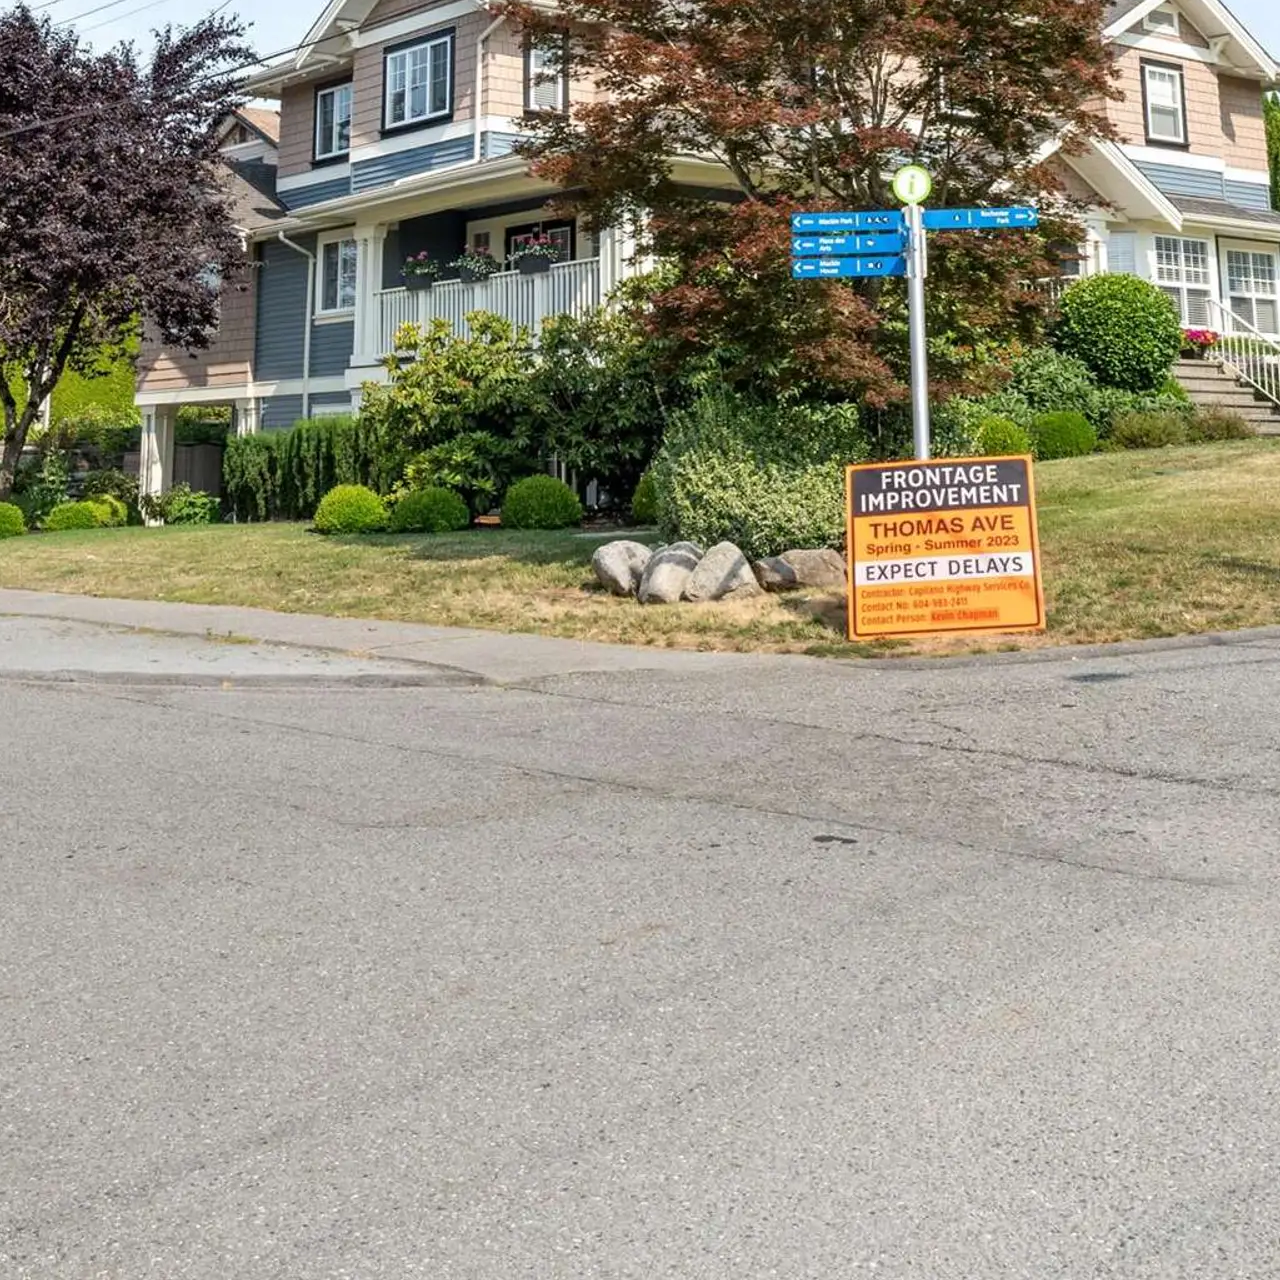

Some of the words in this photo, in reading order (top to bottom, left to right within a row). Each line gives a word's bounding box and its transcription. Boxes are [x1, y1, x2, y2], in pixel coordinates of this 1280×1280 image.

[881, 464, 998, 490] FRONTAGE
[860, 484, 1021, 512] IMPROVEMENT
[869, 517, 964, 539] THOMAS
[971, 514, 1015, 531] AVE
[866, 542, 912, 557] Spring
[924, 537, 982, 551] Summer
[987, 535, 1020, 547] 2023
[866, 561, 938, 581] EXPECT
[948, 556, 1024, 576] DELAYS
[983, 580, 1018, 591] Services
[861, 601, 894, 613] Contact
[861, 614, 894, 626] Contact
